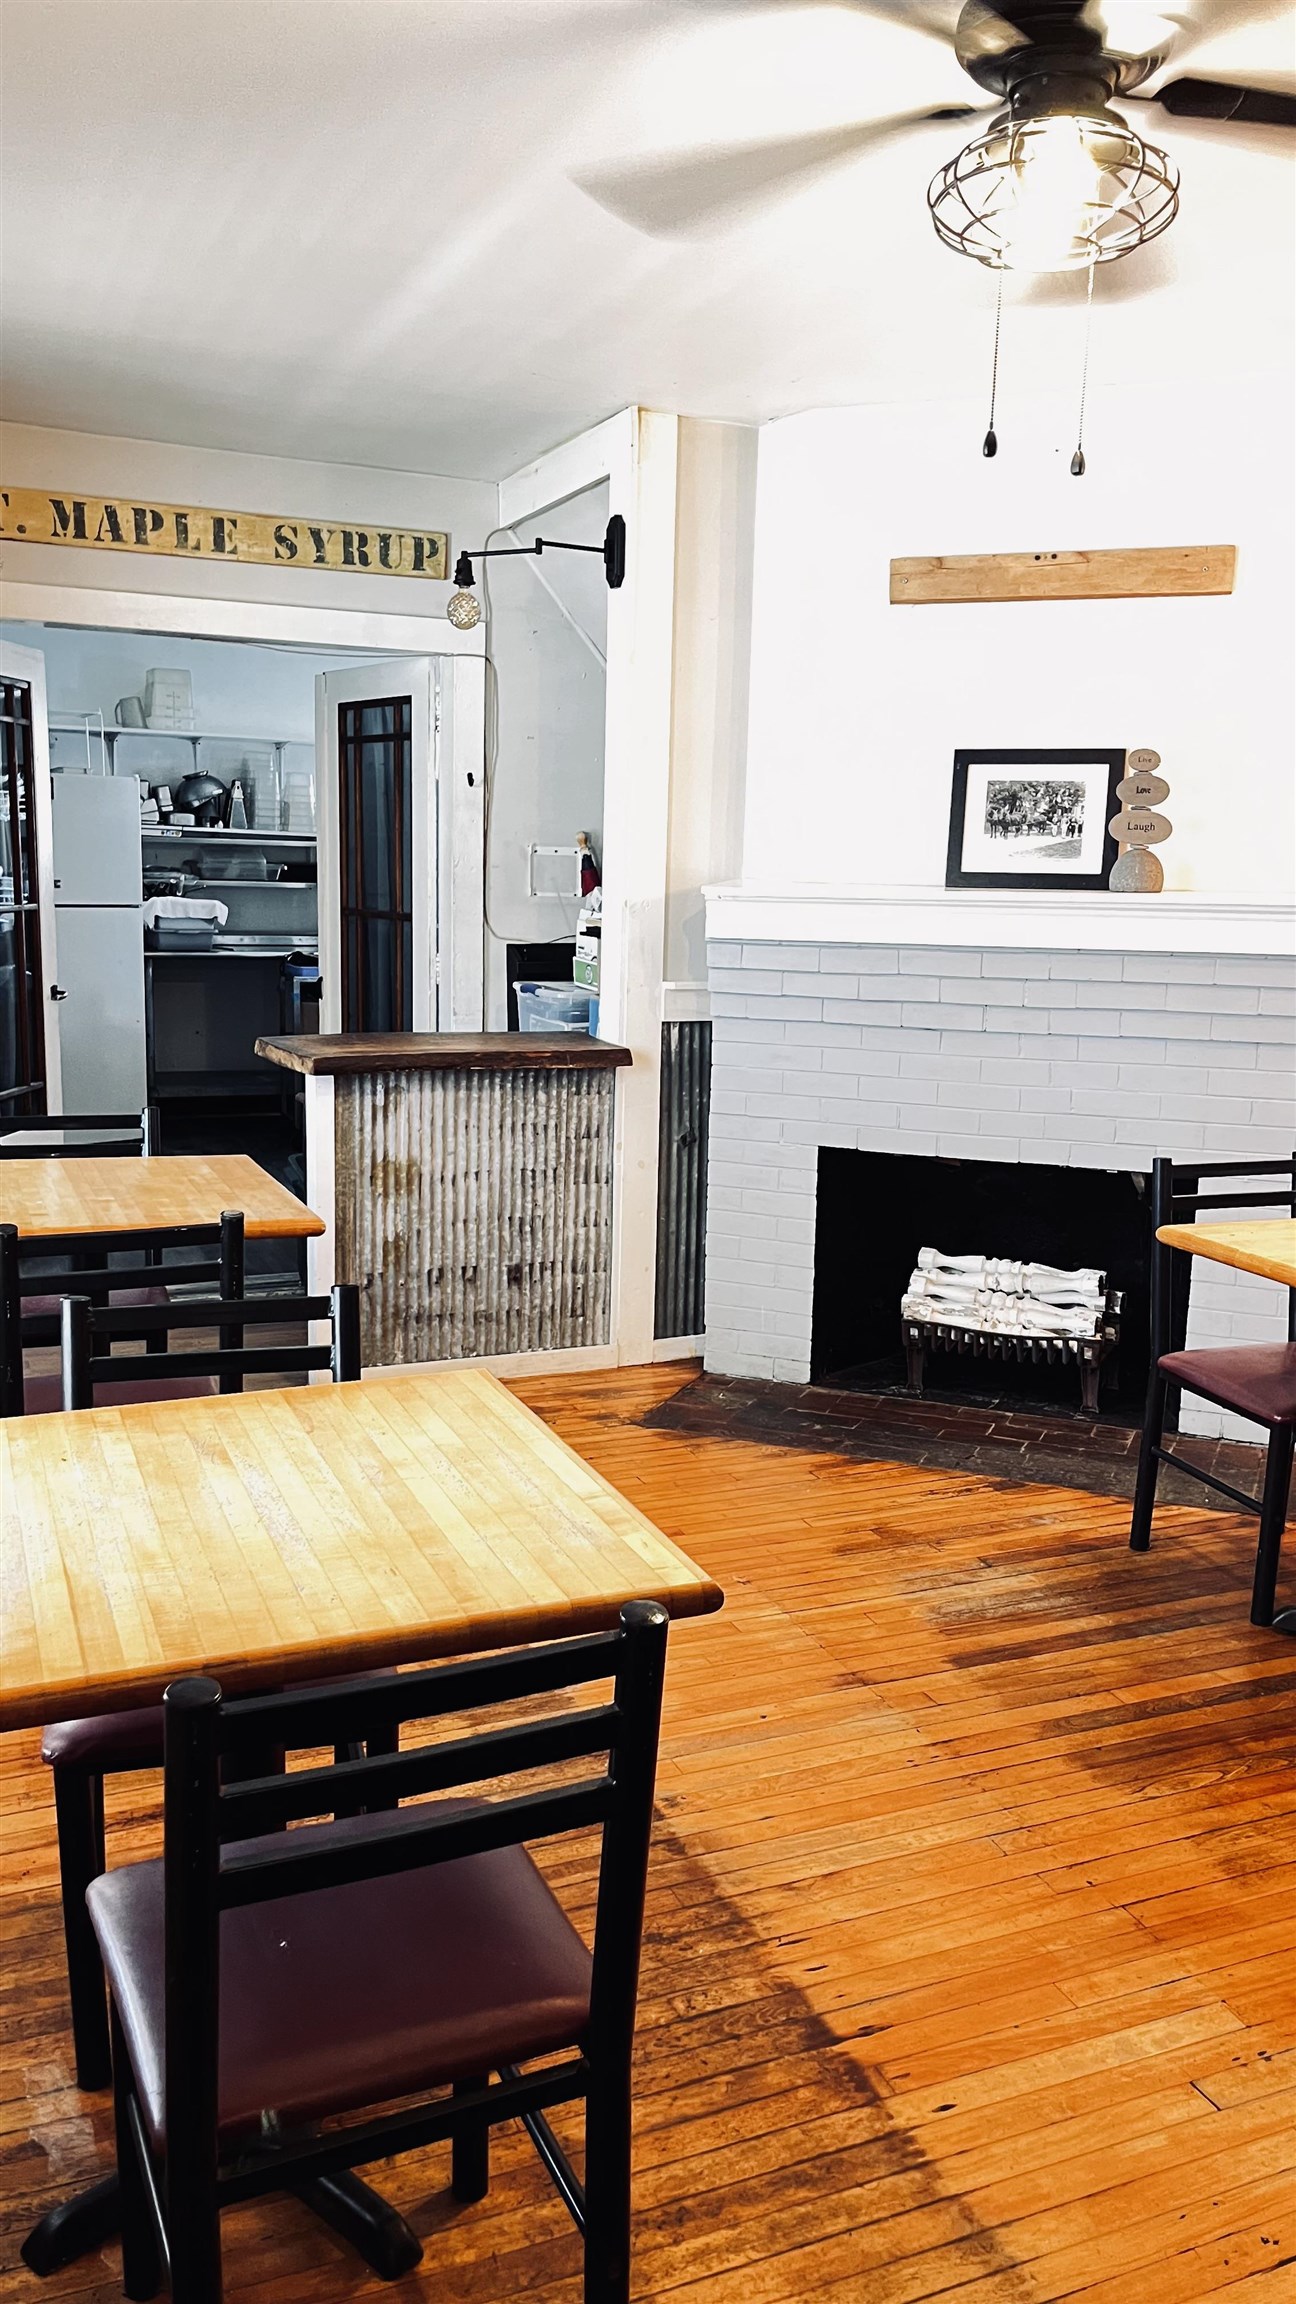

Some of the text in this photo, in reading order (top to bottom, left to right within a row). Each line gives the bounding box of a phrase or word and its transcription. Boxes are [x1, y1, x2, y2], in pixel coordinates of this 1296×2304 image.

[48, 498, 238, 555] MAPLE
[274, 524, 440, 571] SYRUP
[1137, 756, 1153, 764] Live
[1135, 785, 1152, 795] Love
[1127, 821, 1156, 833] Laugh
